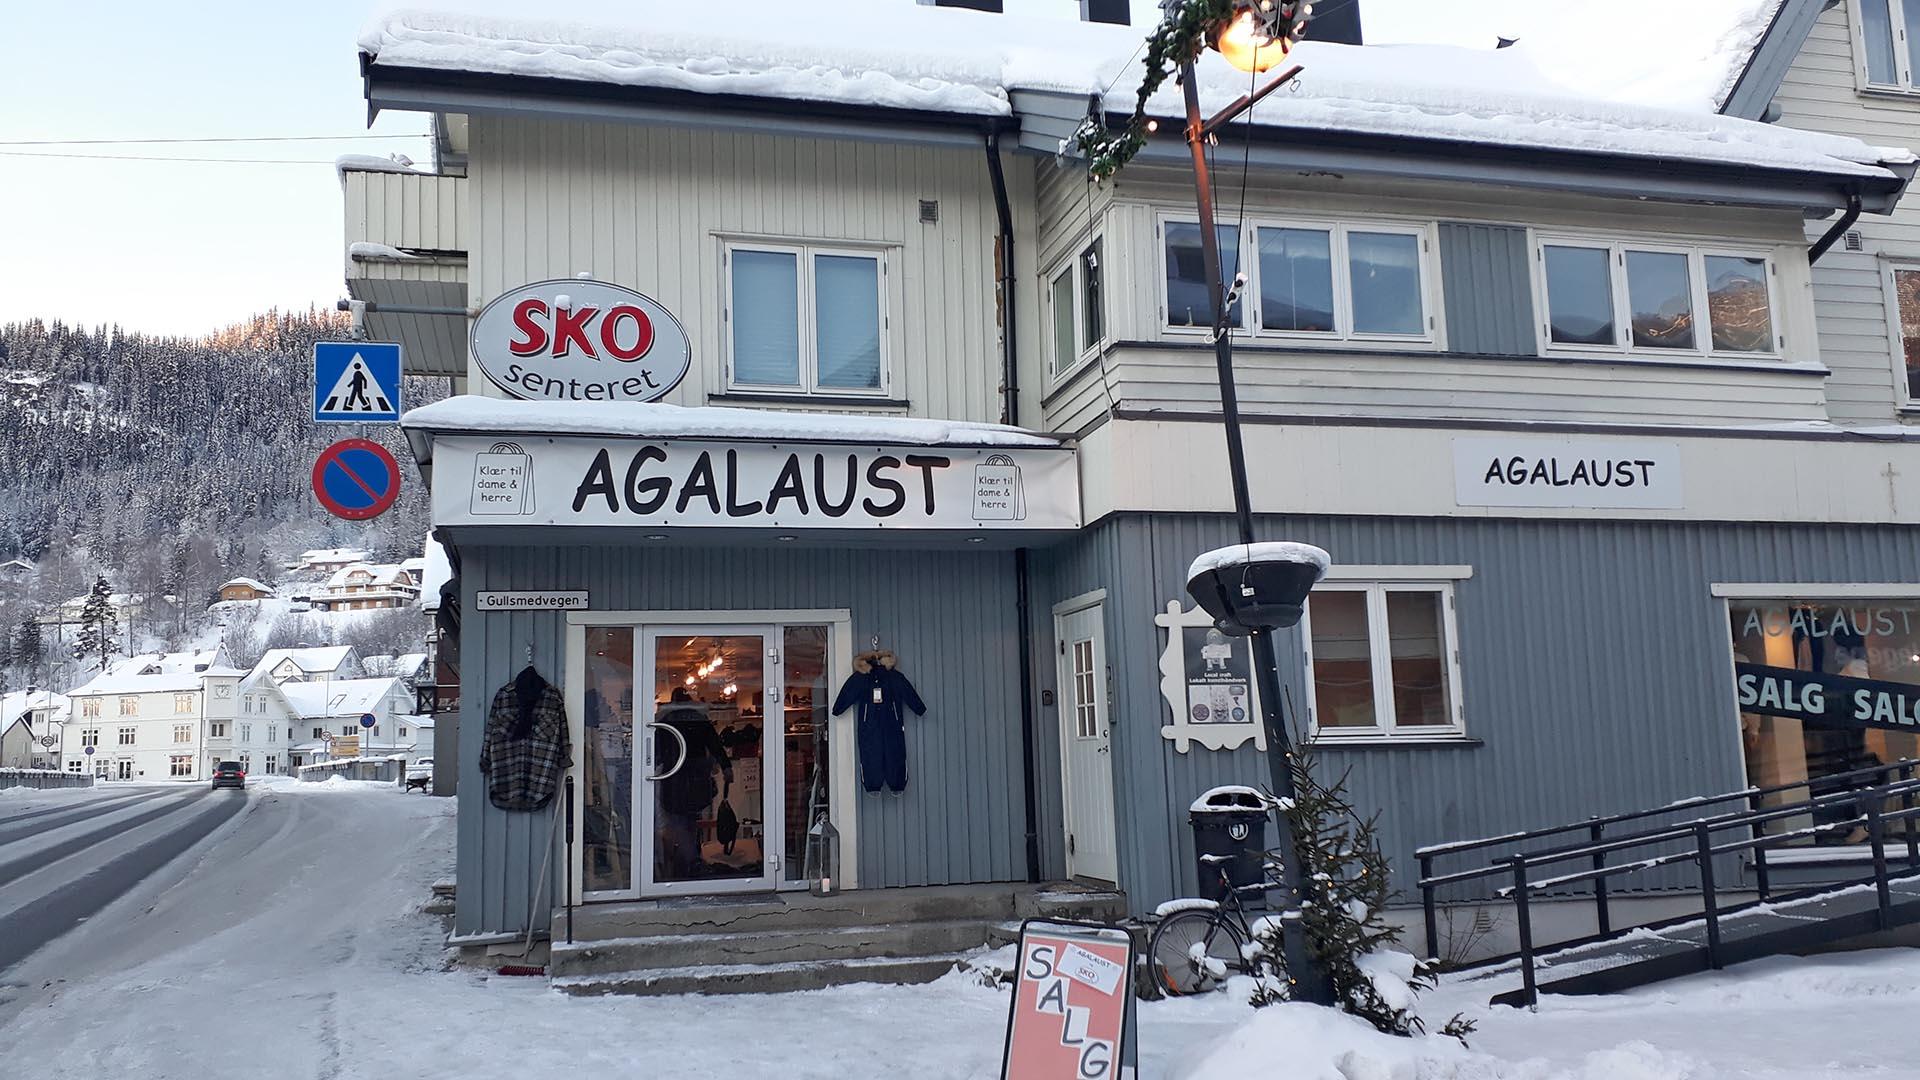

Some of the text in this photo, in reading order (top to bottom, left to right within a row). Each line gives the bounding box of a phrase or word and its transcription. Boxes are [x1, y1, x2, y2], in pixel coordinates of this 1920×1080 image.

[508, 298, 655, 362] SKO
[503, 363, 661, 401] senteret
[479, 465, 522, 476] Klær til
[978, 475, 1013, 485] Klær til
[1484, 456, 1655, 487] AGALAUST
[477, 479, 518, 489] dame &
[571, 445, 951, 518] AGALAUST
[481, 492, 512, 503] herre
[977, 488, 1010, 497] dame &
[981, 499, 1007, 509] herre
[486, 595, 579, 607] Gullsmedvegen
[1743, 607, 1911, 638] AGALAUST
[1738, 674, 1825, 714] SALG
[1854, 689, 1920, 725] SAL
